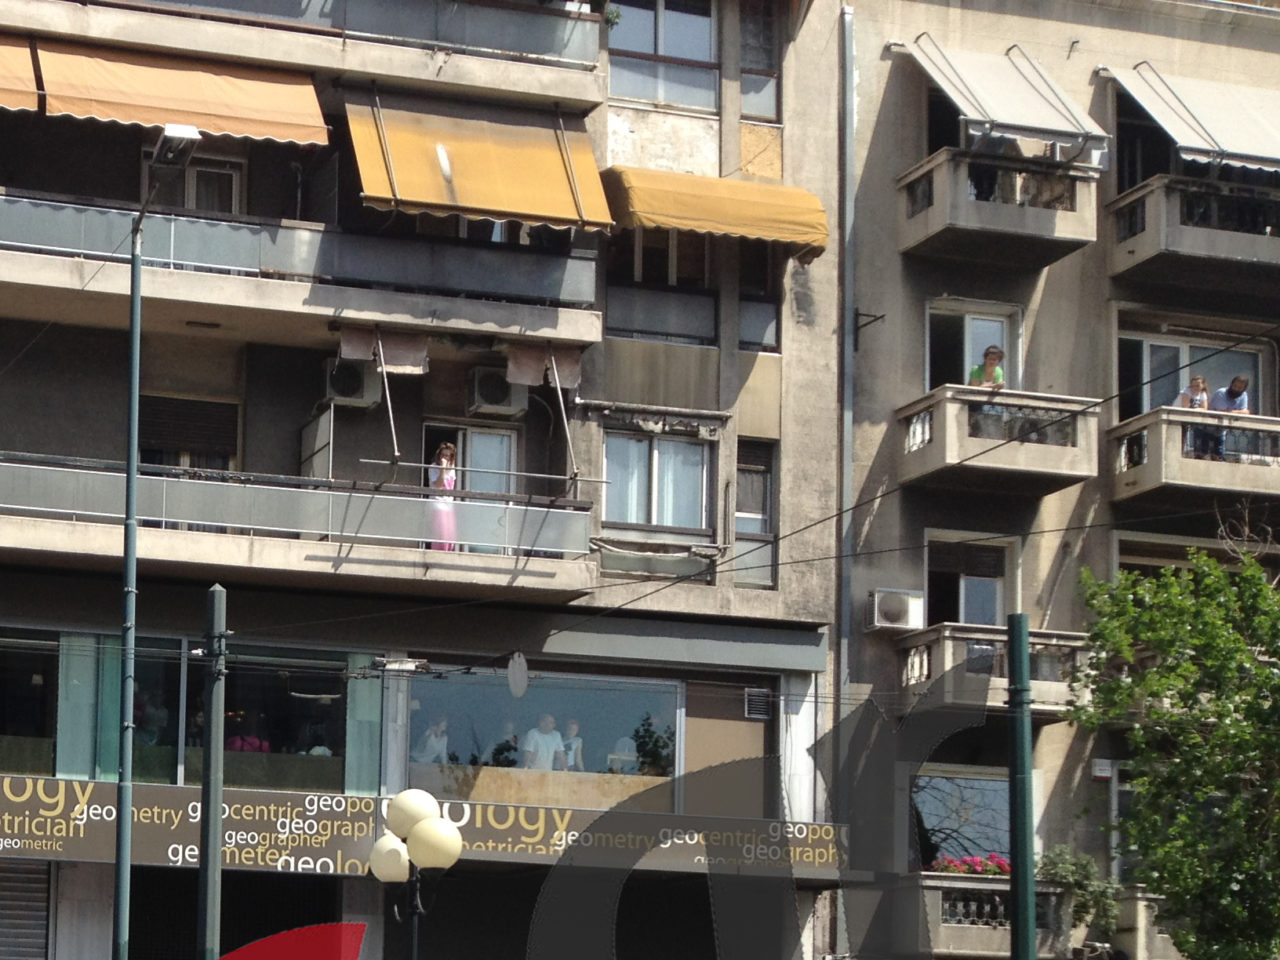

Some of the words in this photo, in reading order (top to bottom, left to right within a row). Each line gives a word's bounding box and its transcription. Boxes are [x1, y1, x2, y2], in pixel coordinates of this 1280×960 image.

[441, 802, 573, 844] ology
[225, 828, 327, 849] geographer
[553, 830, 655, 850] geometry
[659, 828, 768, 848] geocentric
[168, 843, 290, 866] gemeter
